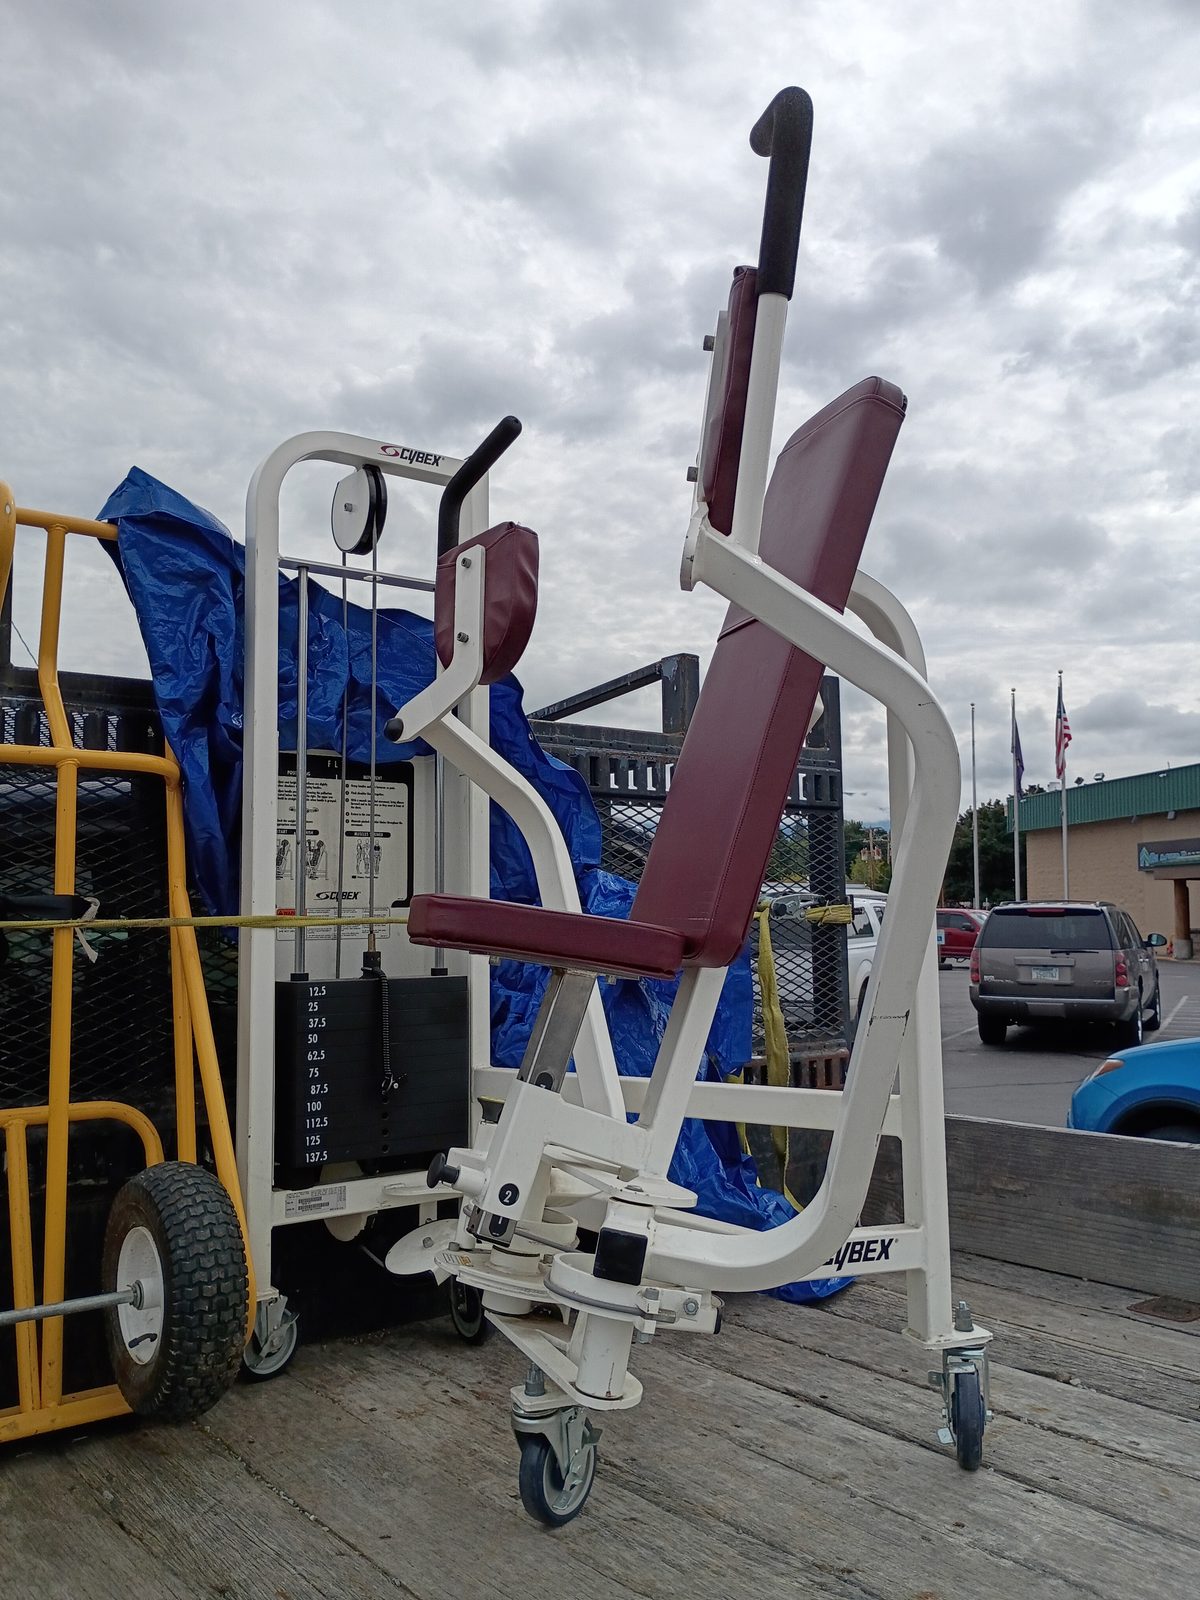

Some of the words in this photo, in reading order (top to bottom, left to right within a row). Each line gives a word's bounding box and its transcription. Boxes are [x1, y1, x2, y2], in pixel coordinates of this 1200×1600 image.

[400, 447, 441, 467] CYBEX
[309, 985, 326, 997] 12.5
[308, 1001, 318, 1012] 25
[308, 1017, 326, 1028] 37.5
[307, 1033, 318, 1044] 50
[307, 1050, 325, 1061] 62.5
[309, 1067, 319, 1078] 75
[310, 1083, 329, 1095] 87.5
[306, 1101, 322, 1112] 100
[306, 1116, 328, 1129] 112.5
[306, 1135, 321, 1147] 125
[306, 1150, 328, 1163] 137.5
[503, 1190, 512, 1203] 2
[822, 1238, 894, 1272] YBEX
